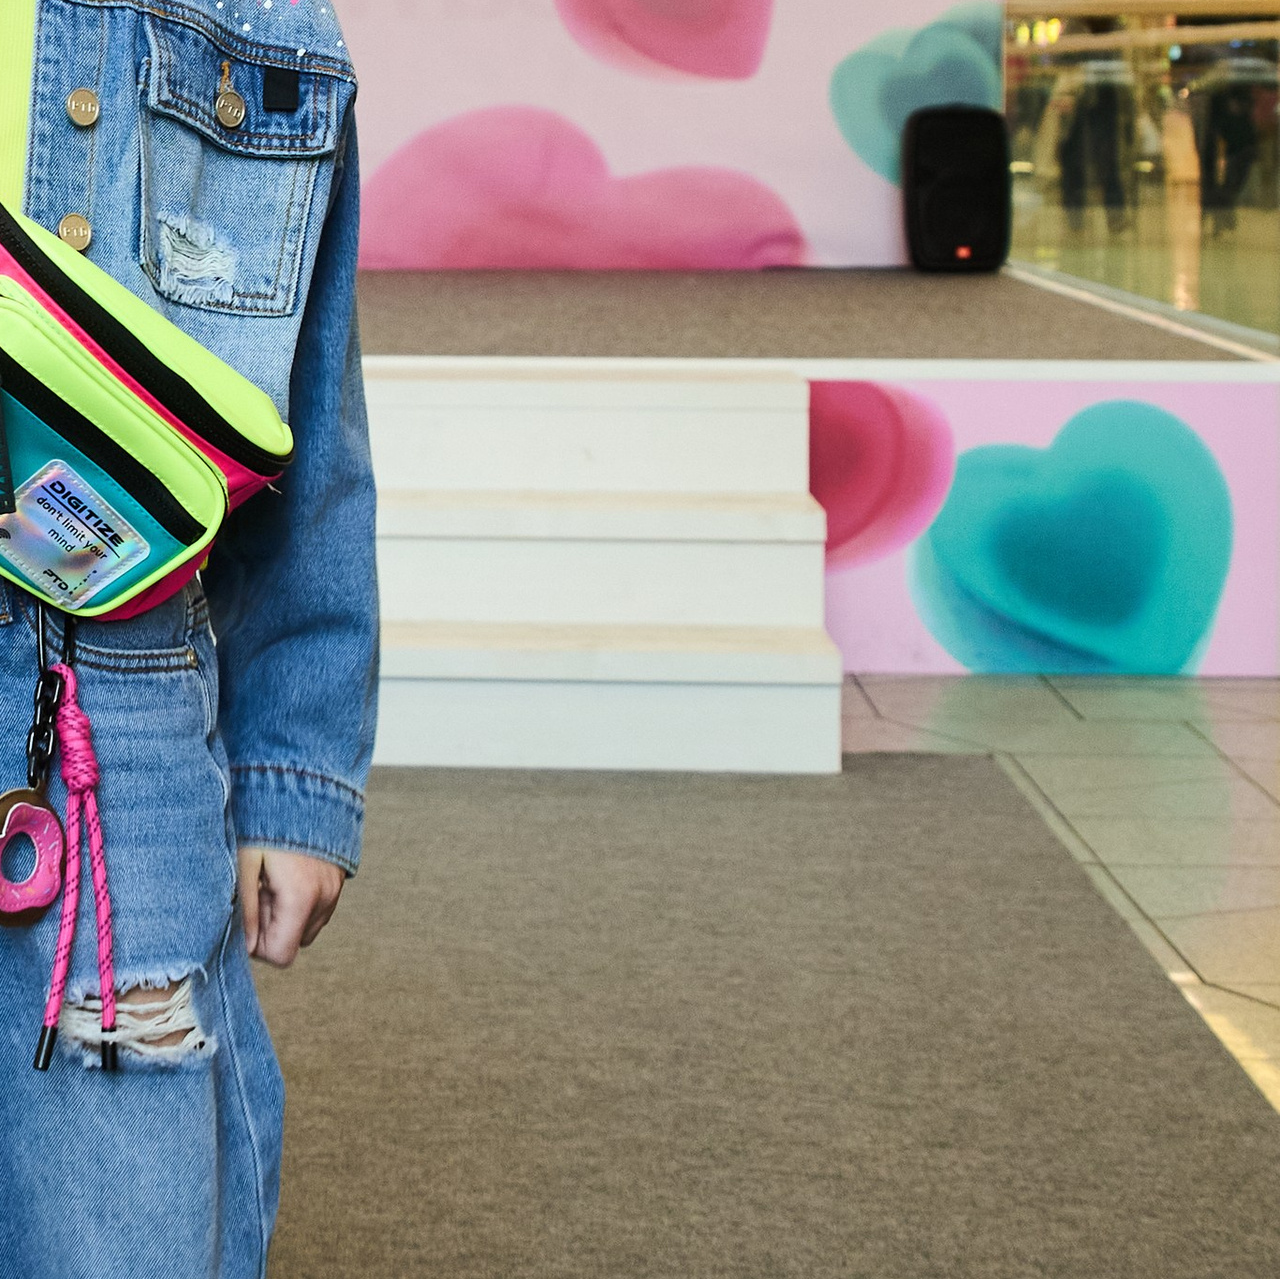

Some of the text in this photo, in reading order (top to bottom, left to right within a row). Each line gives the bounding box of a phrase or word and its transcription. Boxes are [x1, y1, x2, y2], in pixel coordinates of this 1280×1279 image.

[36, 496, 109, 560] don't limit your
[49, 480, 125, 548] DIGITIZE
[47, 528, 75, 553] mind
[42, 569, 70, 592] PTD
